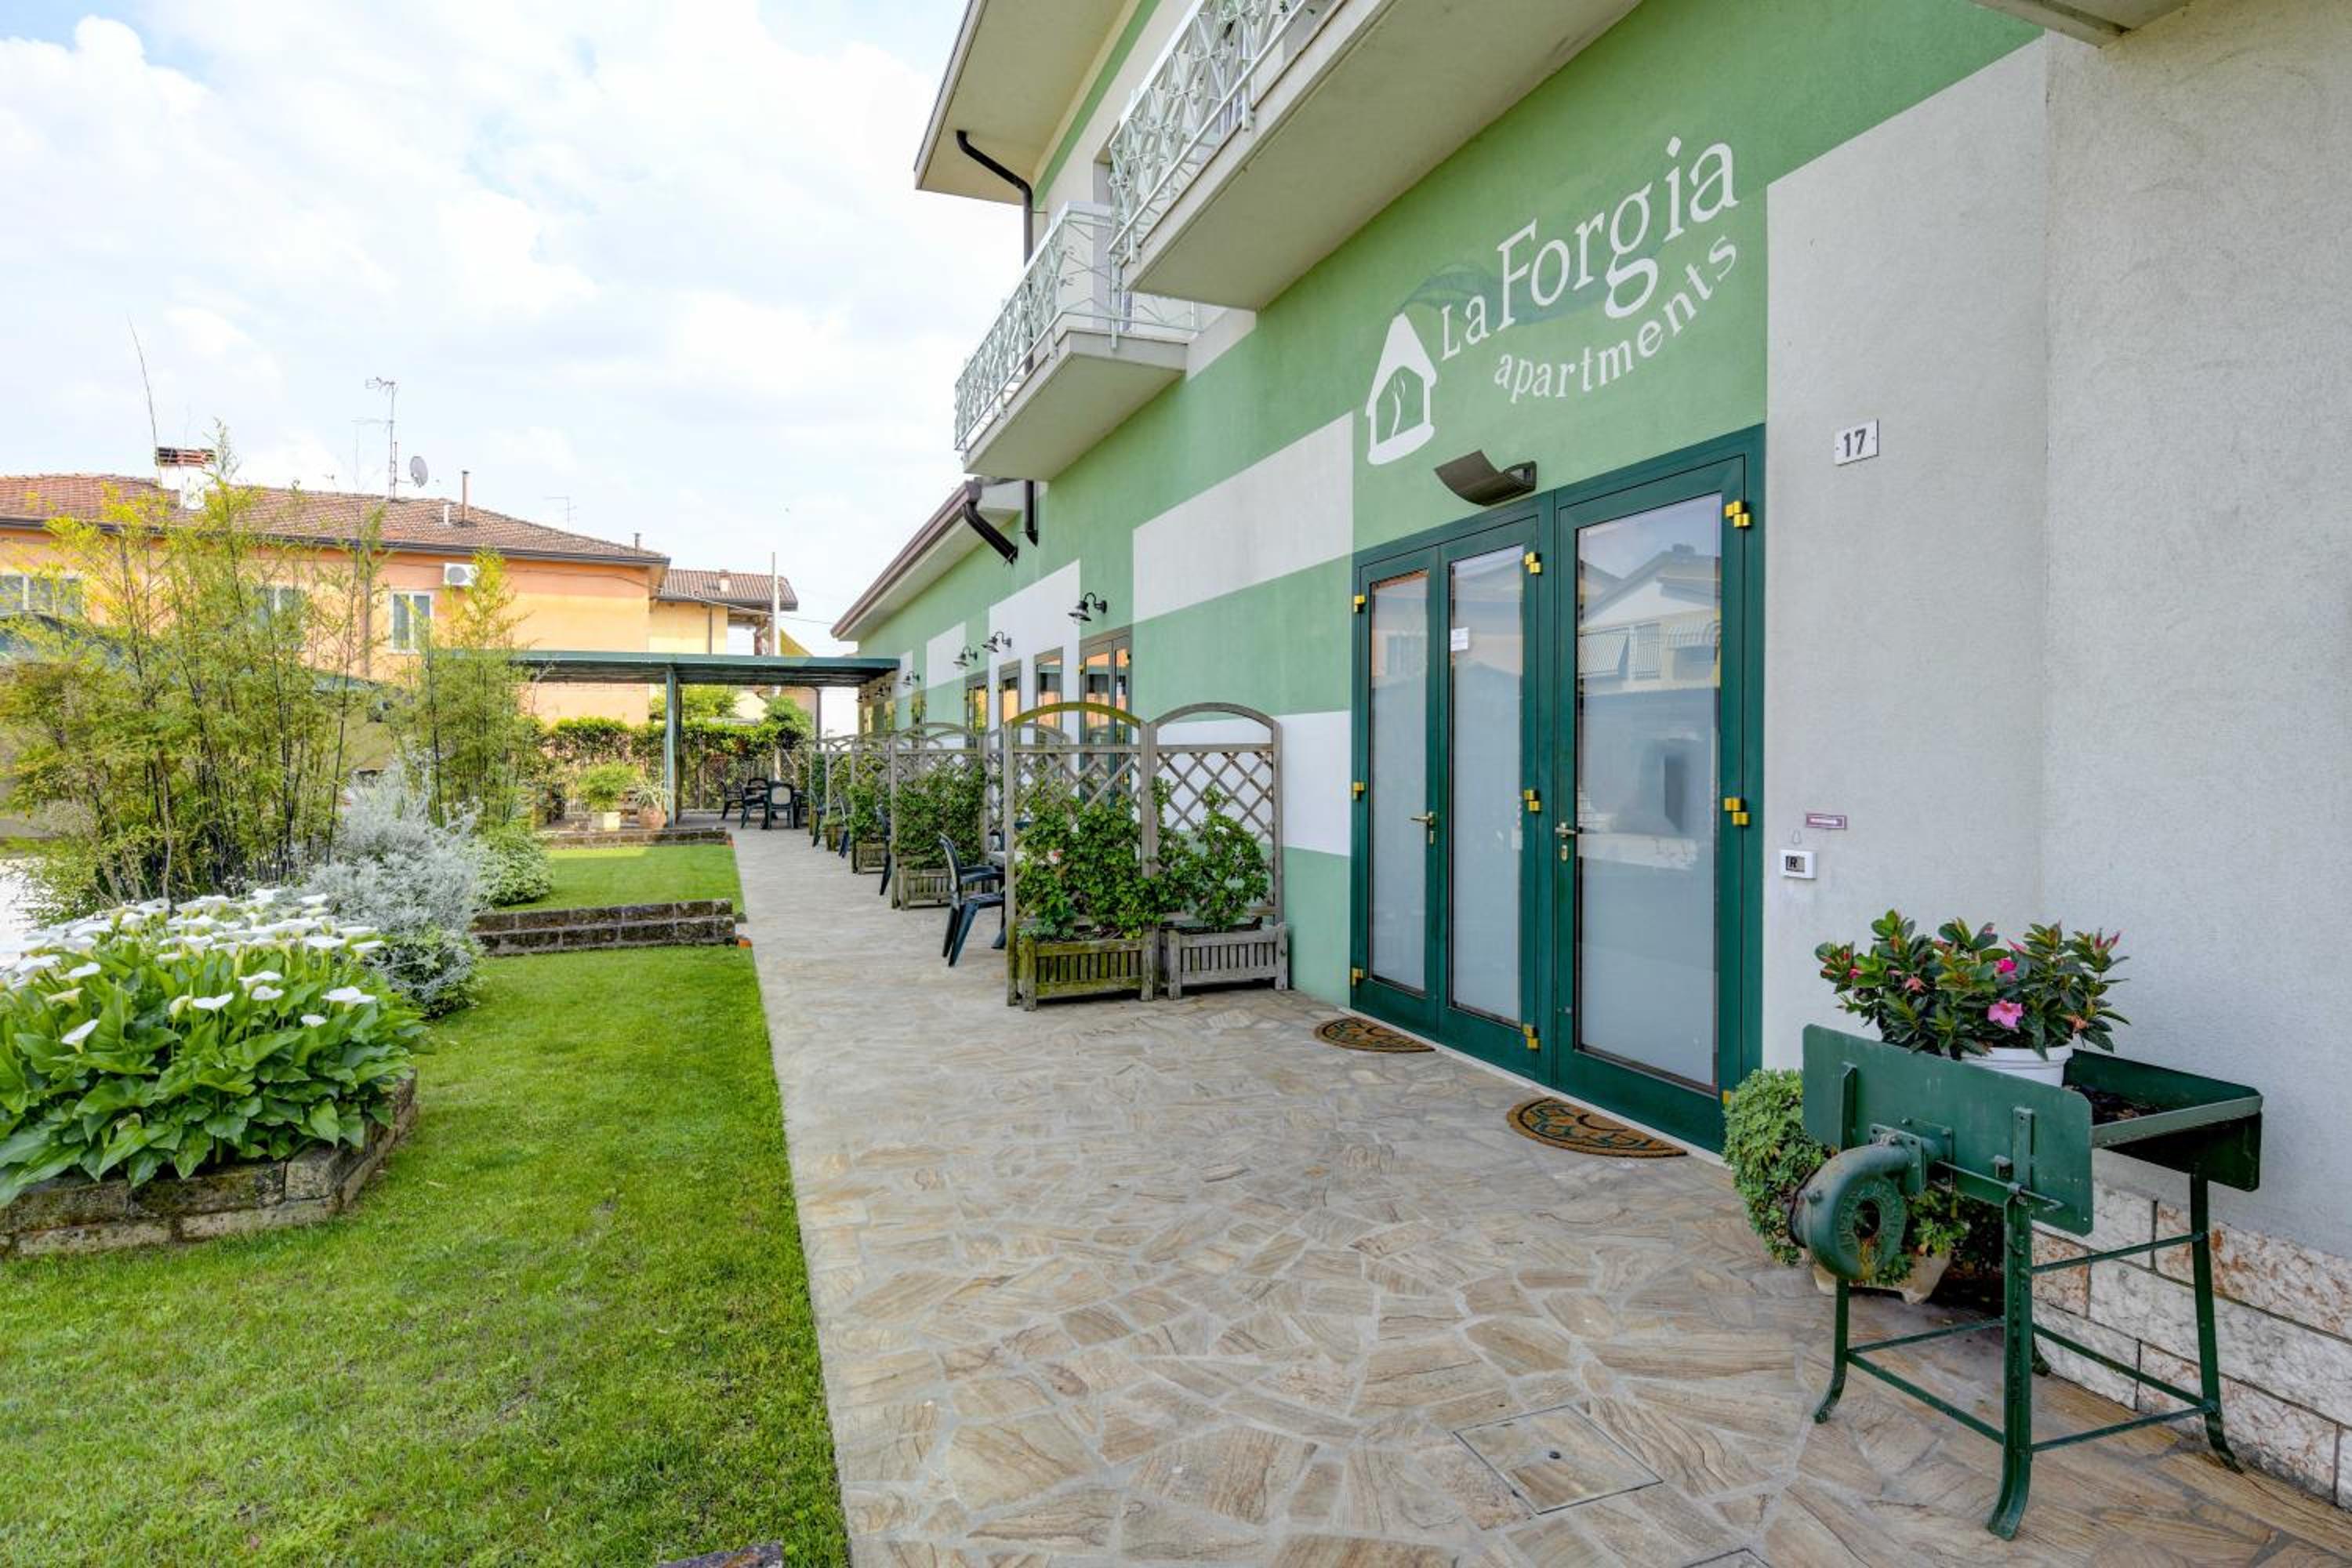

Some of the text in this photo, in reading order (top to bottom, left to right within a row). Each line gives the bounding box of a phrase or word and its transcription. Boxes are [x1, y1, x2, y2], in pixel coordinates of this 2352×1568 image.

[1441, 136, 1740, 361] La Forgia
[1494, 236, 1737, 404] apartments
[1843, 428, 1867, 457] 17
